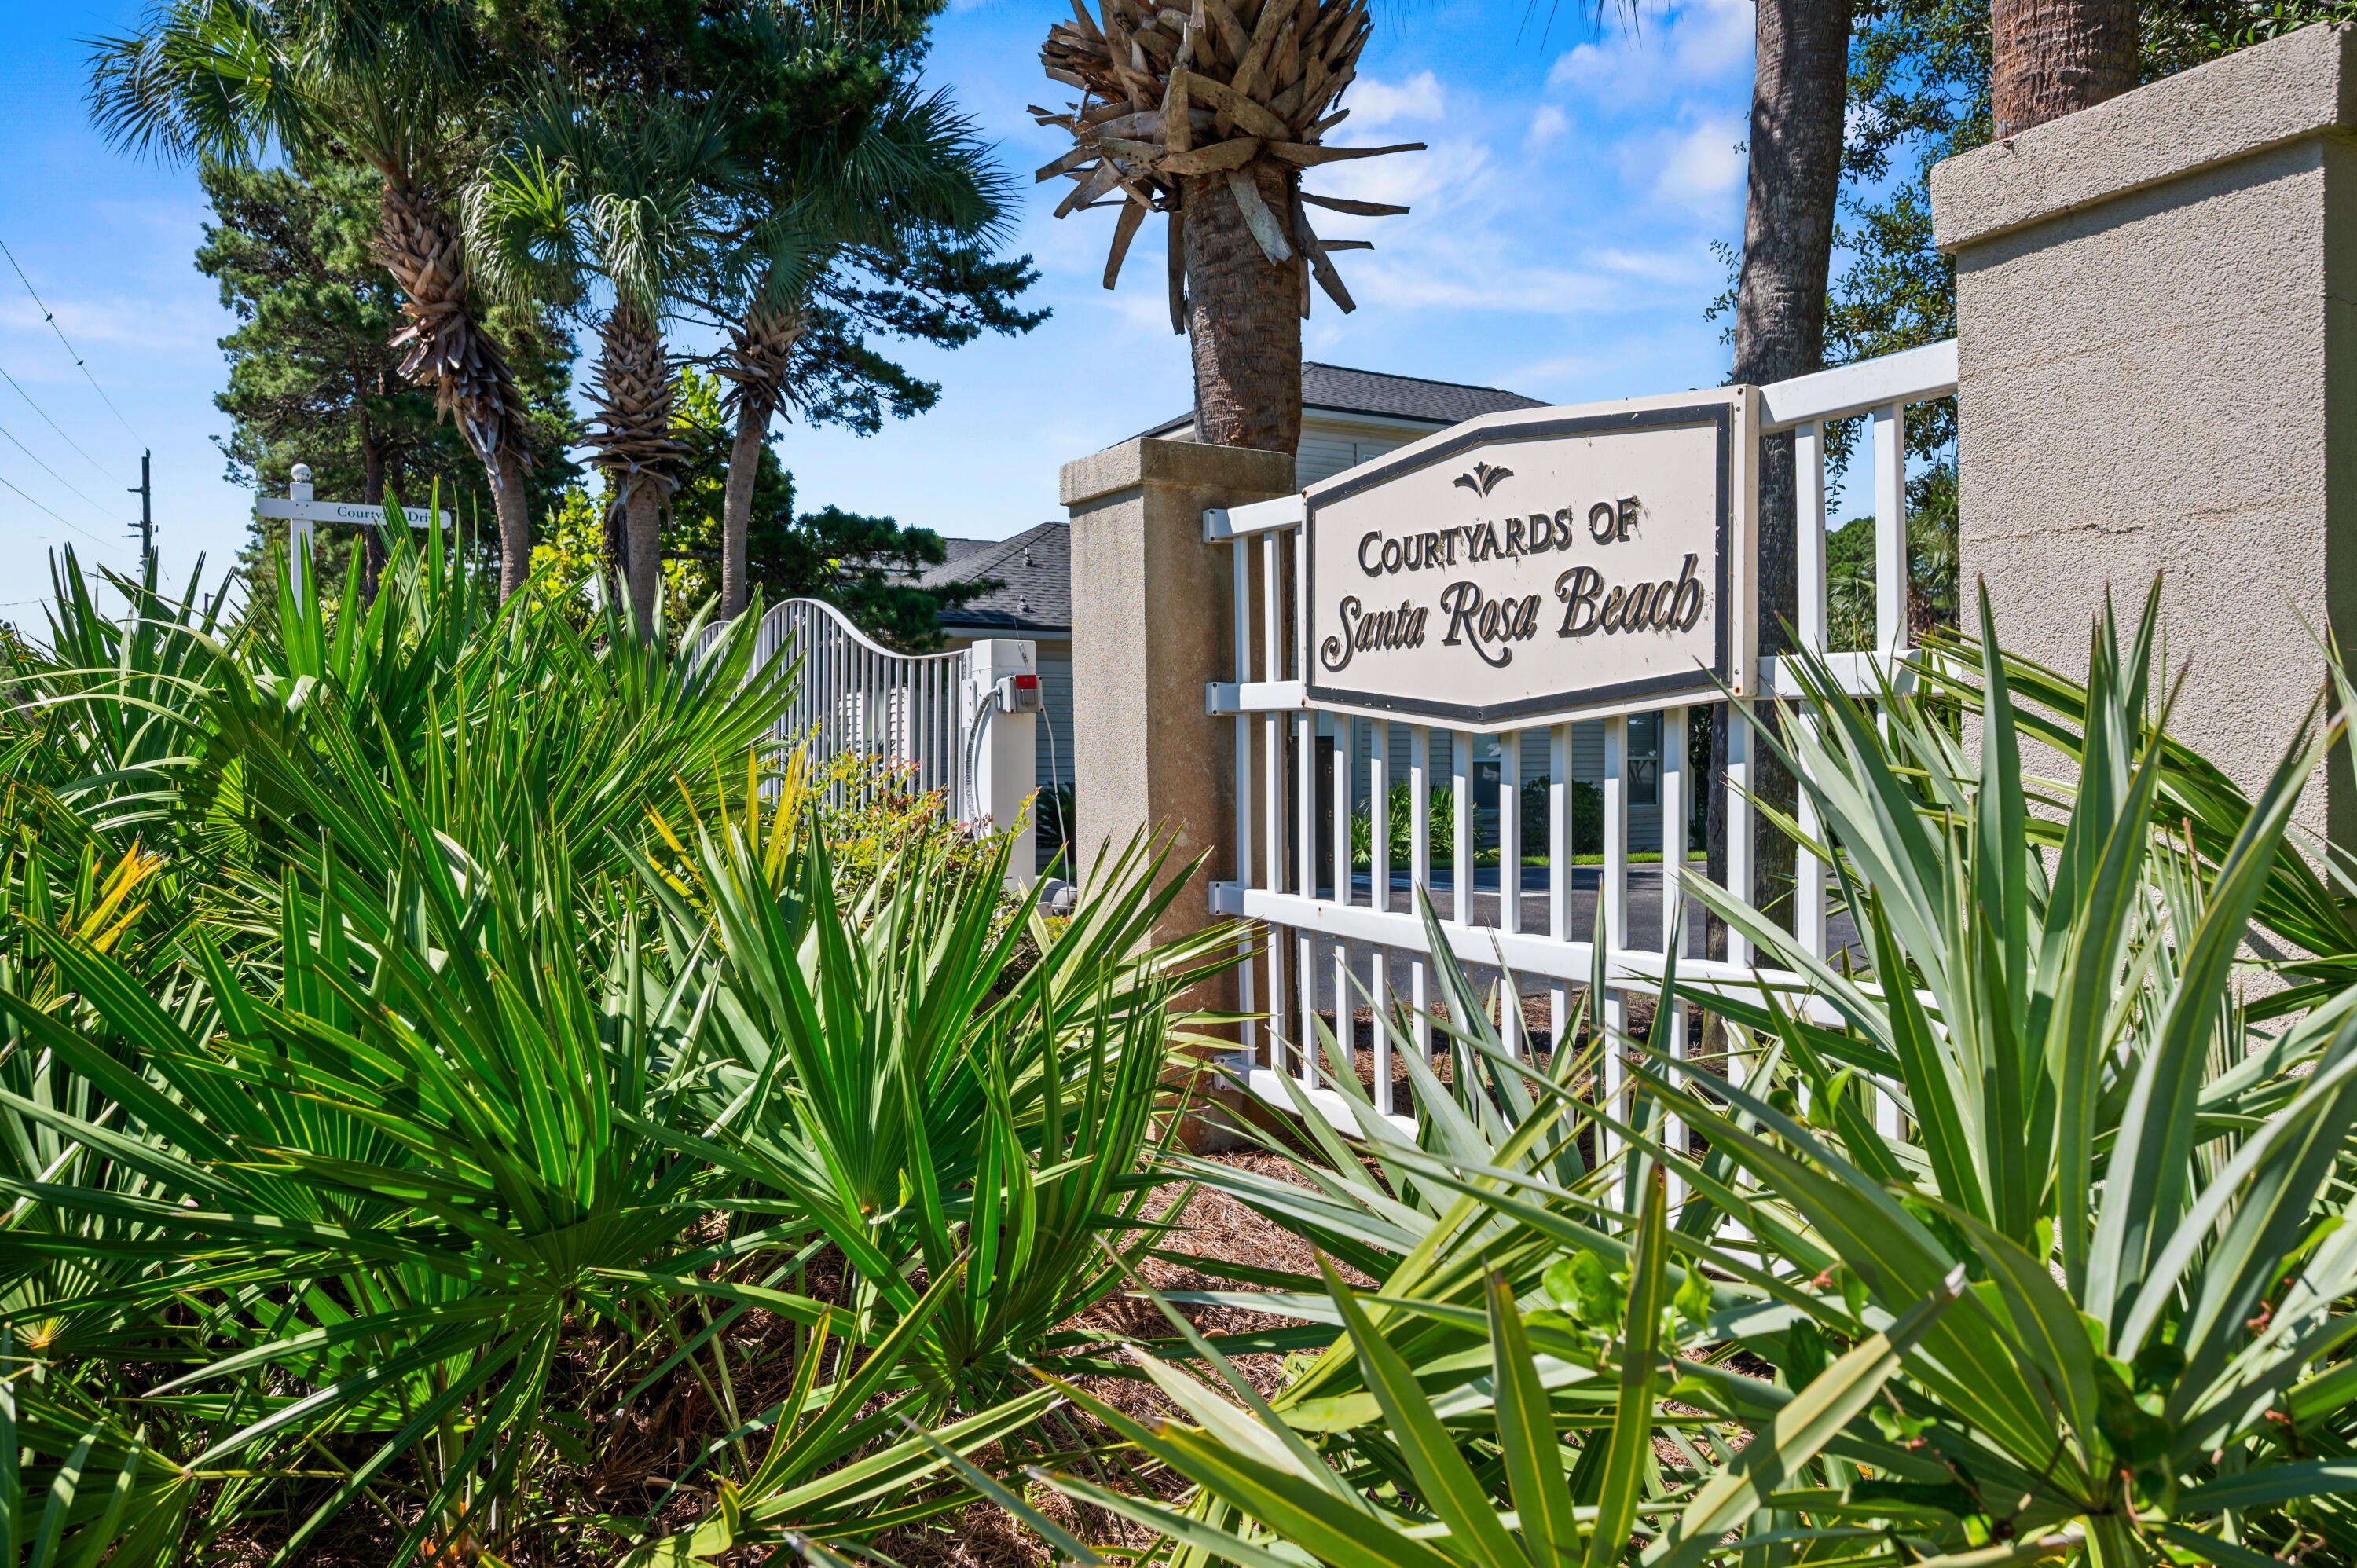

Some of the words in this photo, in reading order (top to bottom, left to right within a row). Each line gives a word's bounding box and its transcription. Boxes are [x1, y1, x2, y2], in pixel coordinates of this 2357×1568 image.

[408, 511, 442, 523] Dri
[1358, 507, 1573, 577] COURTYARDS
[1588, 496, 1640, 545] OF
[1321, 595, 1428, 672] Santa
[1440, 581, 1541, 668] Rosa
[1555, 553, 1703, 638] Beach
